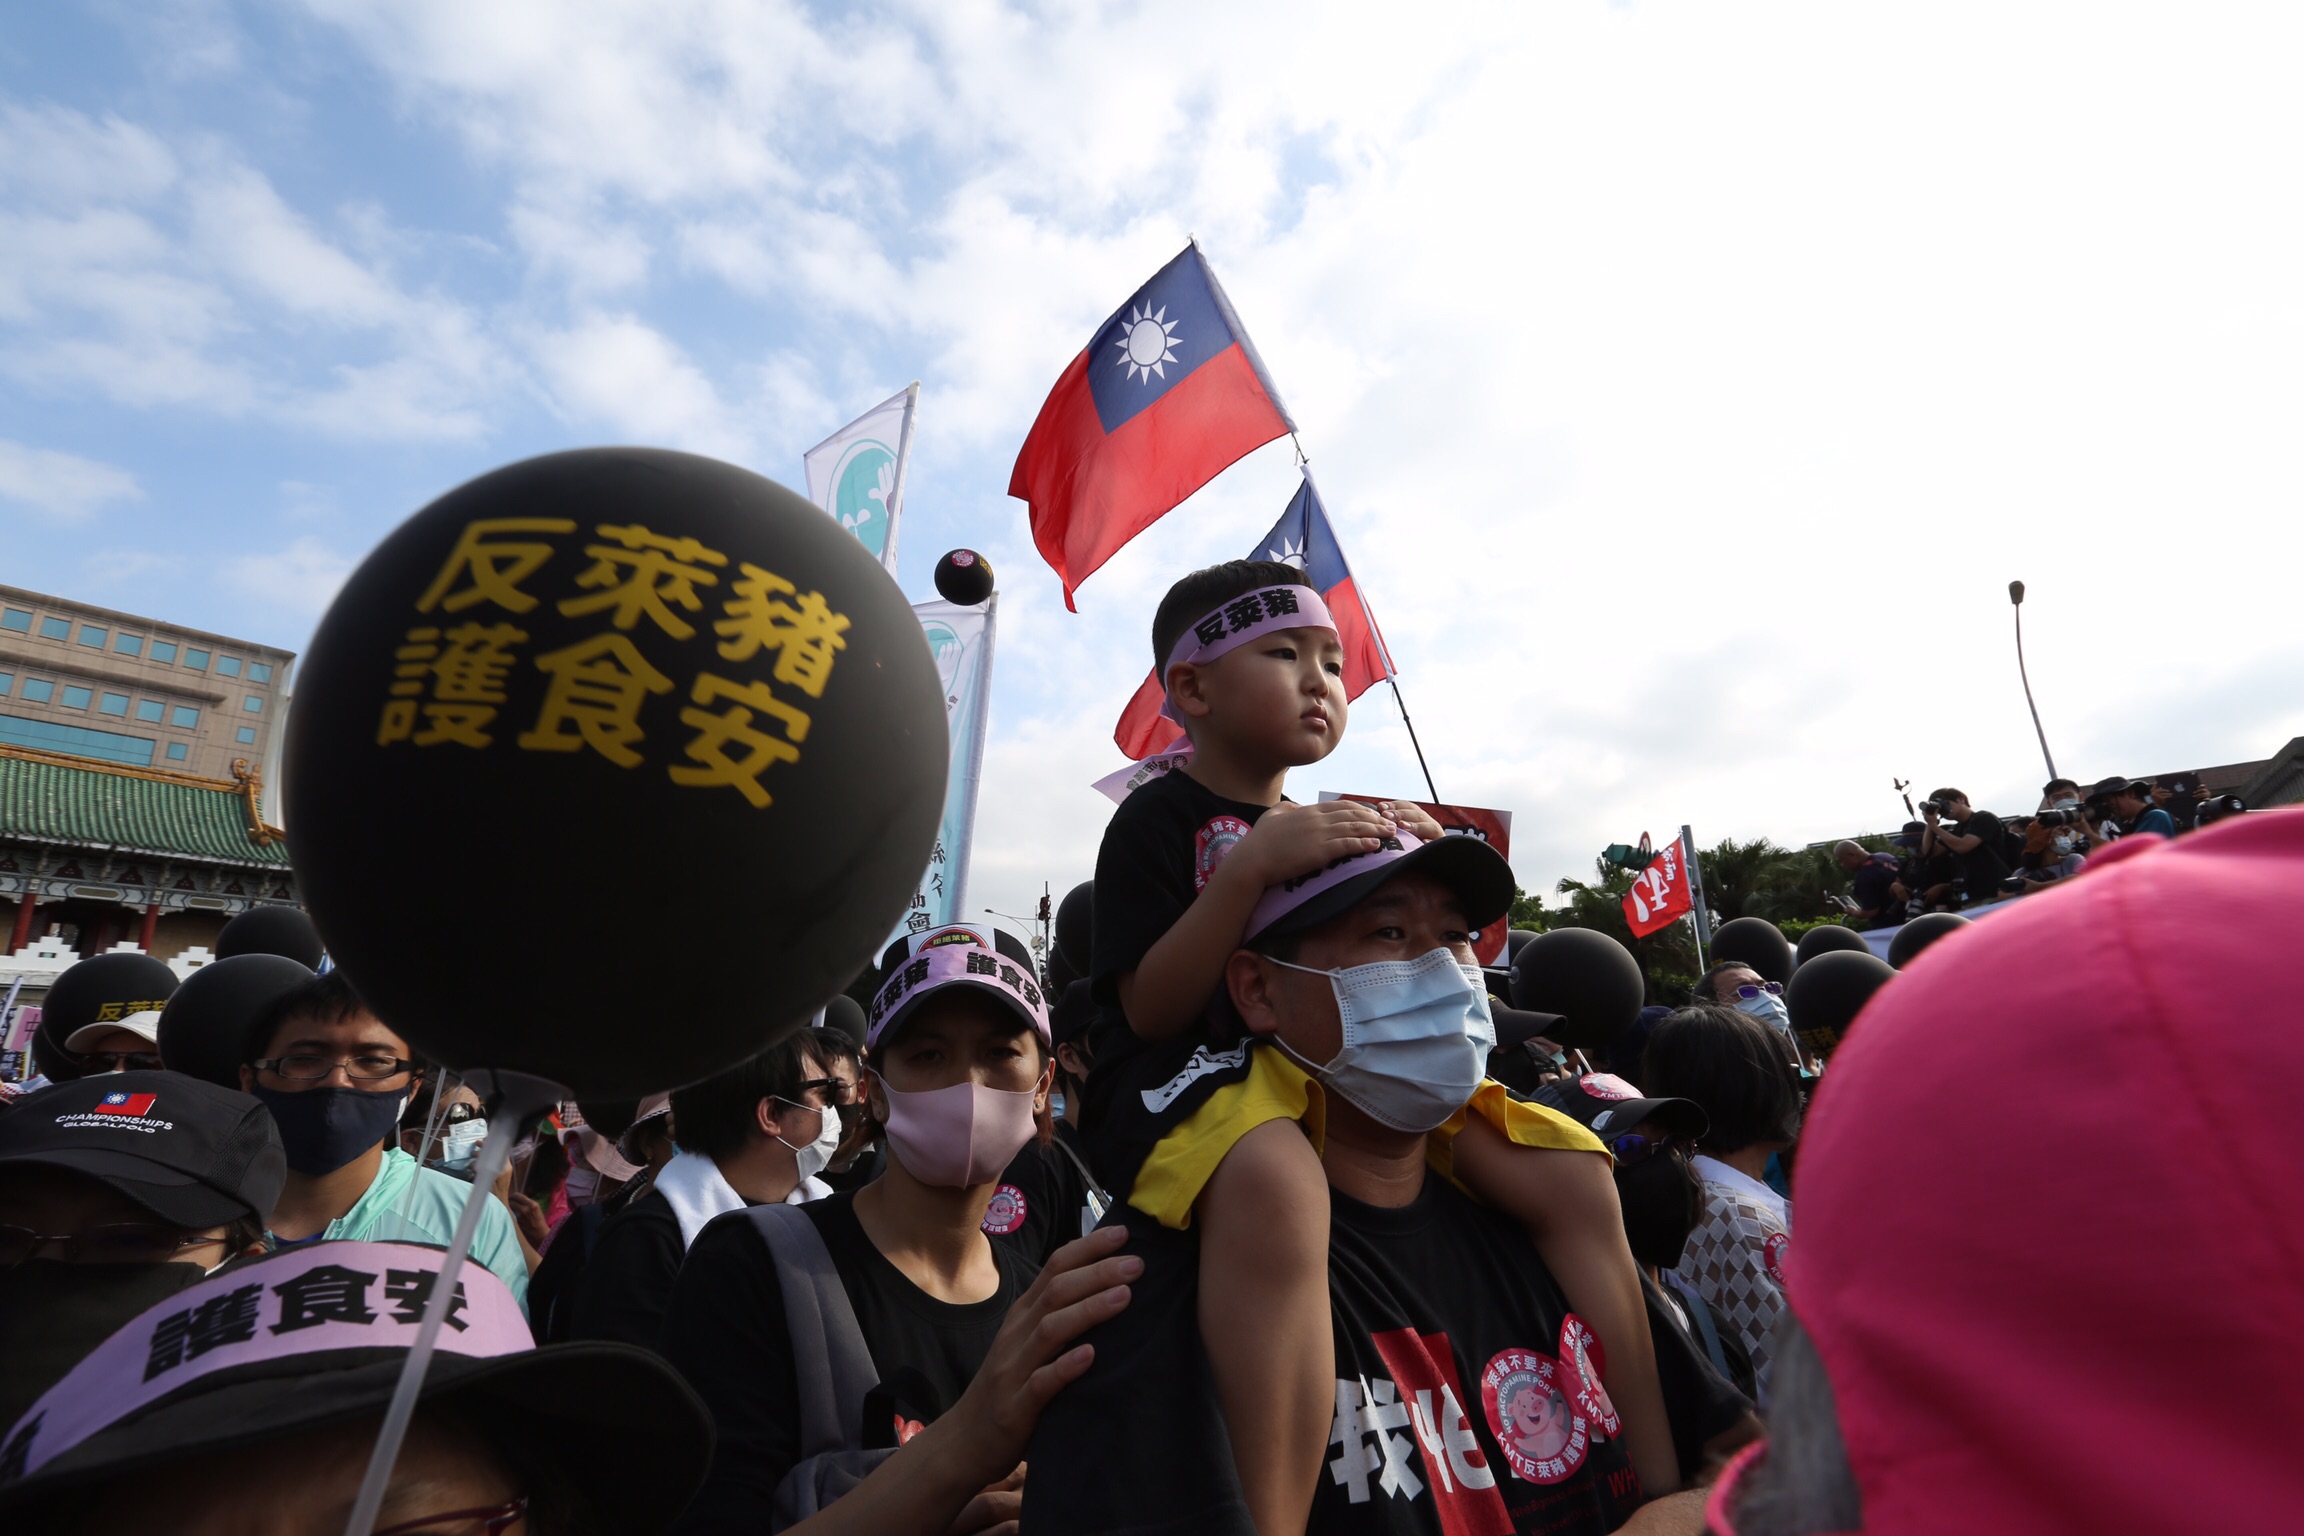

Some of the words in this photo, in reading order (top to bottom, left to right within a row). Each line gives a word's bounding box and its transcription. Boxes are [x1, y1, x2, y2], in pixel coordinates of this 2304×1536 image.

[416, 518, 851, 698] 反萊豬
[1194, 588, 1300, 647] 反萊豬
[377, 622, 811, 809] 護食安
[869, 957, 930, 1030] 反萊豬
[966, 951, 1040, 1012] 護食安
[55, 1113, 174, 1131] CHAMPIONSHIPS
[142, 1263, 471, 1384] 護食安
[1486, 1354, 1555, 1389] 萊豬不要來
[1500, 1374, 1531, 1417] RACTOPAMINE
[1532, 1377, 1556, 1397] PORK
[1503, 1420, 1513, 1434] NO
